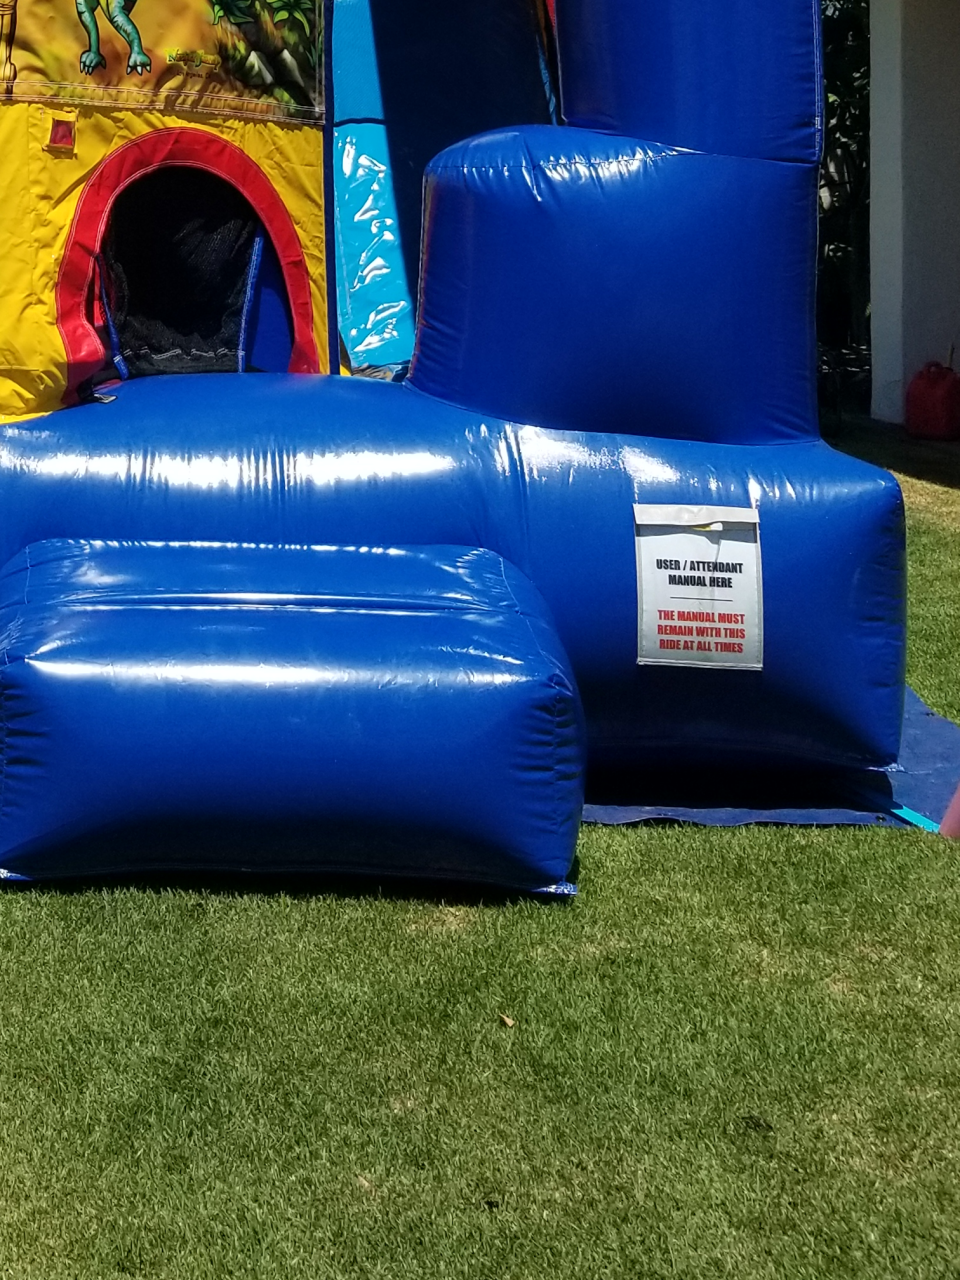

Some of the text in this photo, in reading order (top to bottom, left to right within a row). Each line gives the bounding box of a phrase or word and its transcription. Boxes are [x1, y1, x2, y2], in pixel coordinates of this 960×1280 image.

[656, 559, 743, 574] USER / ATTENDANT
[668, 574, 733, 588] MANUAL HERE
[657, 609, 745, 624] THE MANUAL MUST
[657, 624, 745, 639] REMAIN WITH THIS
[659, 639, 744, 653] RIDE AT ALL TIMES
